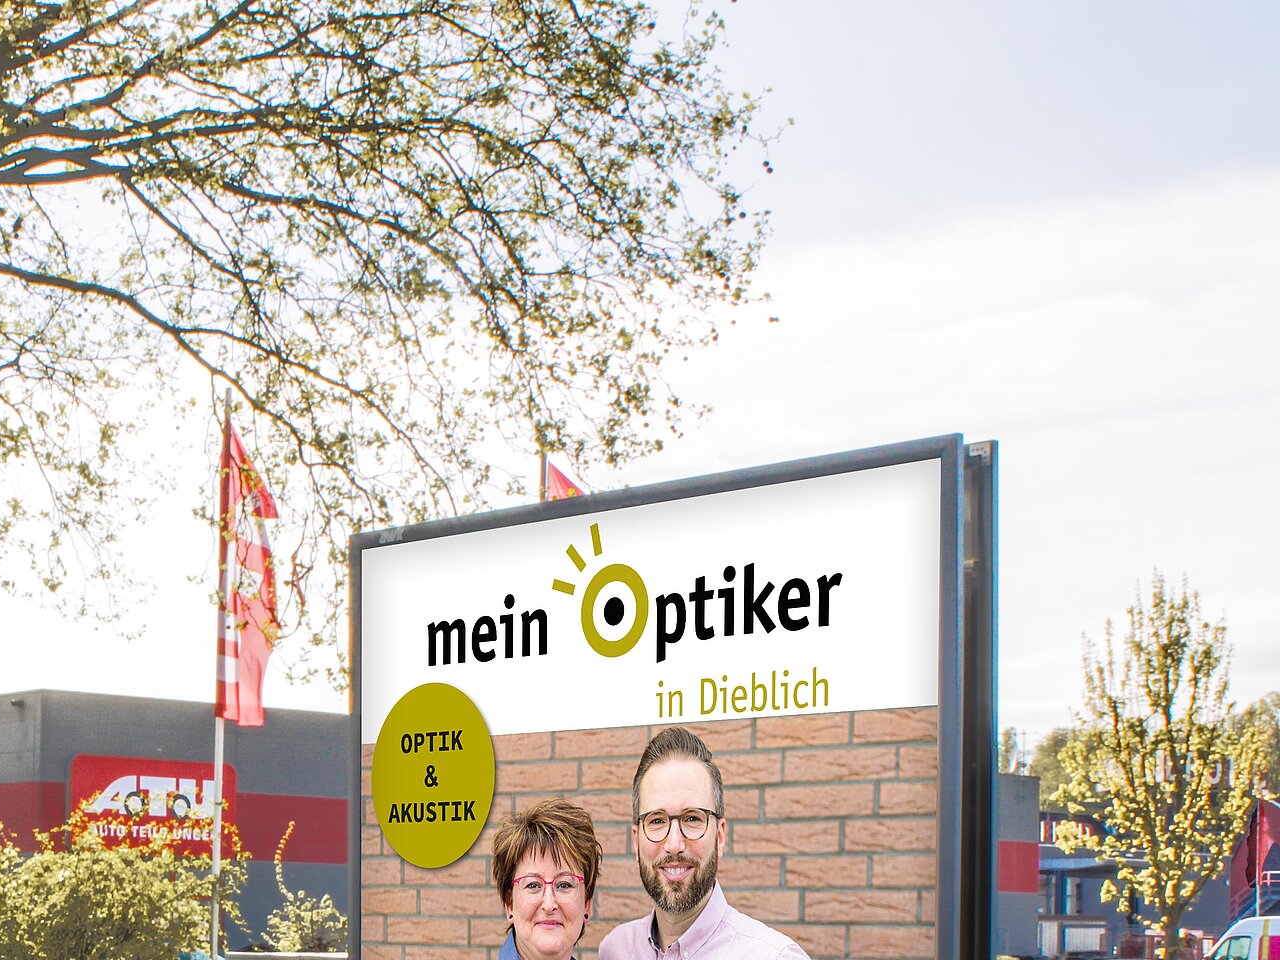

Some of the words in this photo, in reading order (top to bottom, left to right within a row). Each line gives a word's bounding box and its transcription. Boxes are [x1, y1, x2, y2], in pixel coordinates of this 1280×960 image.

[428, 593, 548, 667] mein
[581, 561, 843, 664] Optiker
[655, 680, 685, 718] in
[700, 667, 830, 715] Dieblich
[400, 730, 464, 755] OPTIK
[424, 765, 439, 787] &
[84, 775, 216, 819] ATU
[388, 800, 477, 824] AKUSTIK
